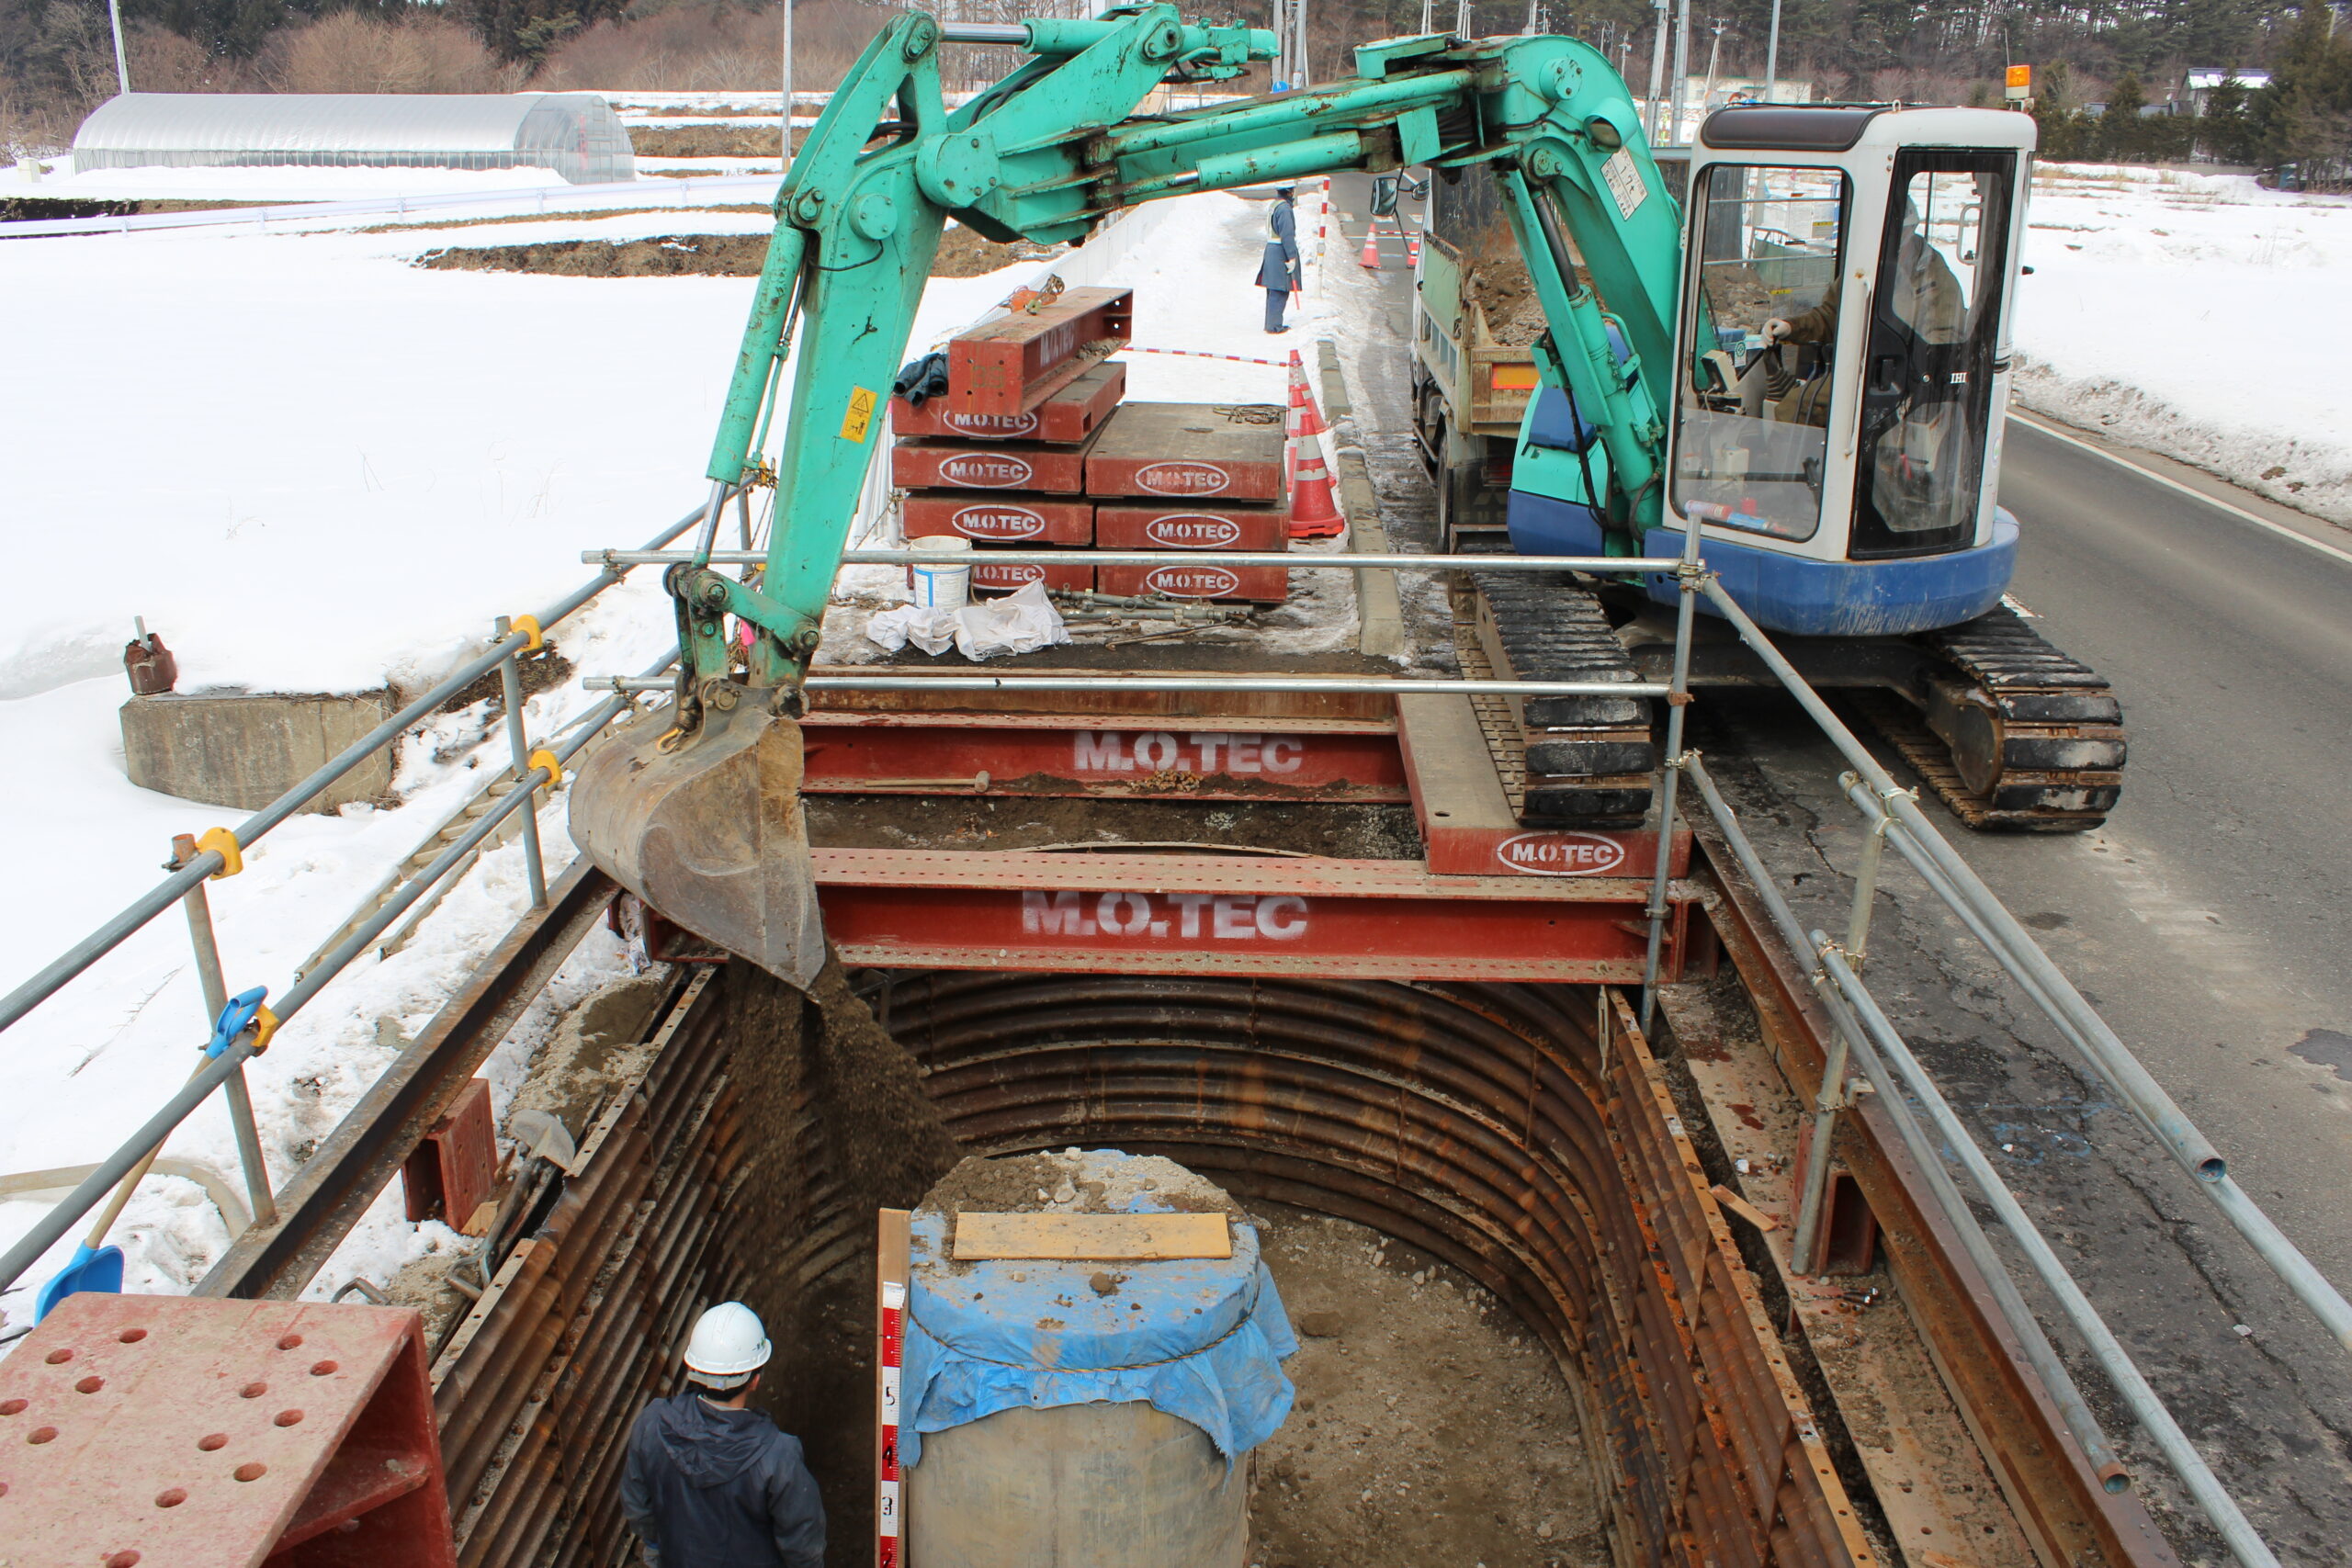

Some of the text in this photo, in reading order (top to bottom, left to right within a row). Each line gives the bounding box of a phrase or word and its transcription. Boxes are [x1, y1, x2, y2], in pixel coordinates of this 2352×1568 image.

[1950, 372, 1967, 384] IHI
[950, 462, 1024, 479] M.O.TEC
[963, 513, 1036, 532] M.O.TEC
[1158, 523, 1232, 539] M.O.TEC
[1158, 573, 1230, 590] M.O.TEC
[1073, 730, 1303, 773] M.O.TEC
[1512, 843, 1613, 863] M.O.TEC
[1022, 889, 1308, 941] M.O.TEC
[886, 1386, 896, 1406] 5
[882, 1445, 893, 1467] 4
[881, 1496, 893, 1516] 3
